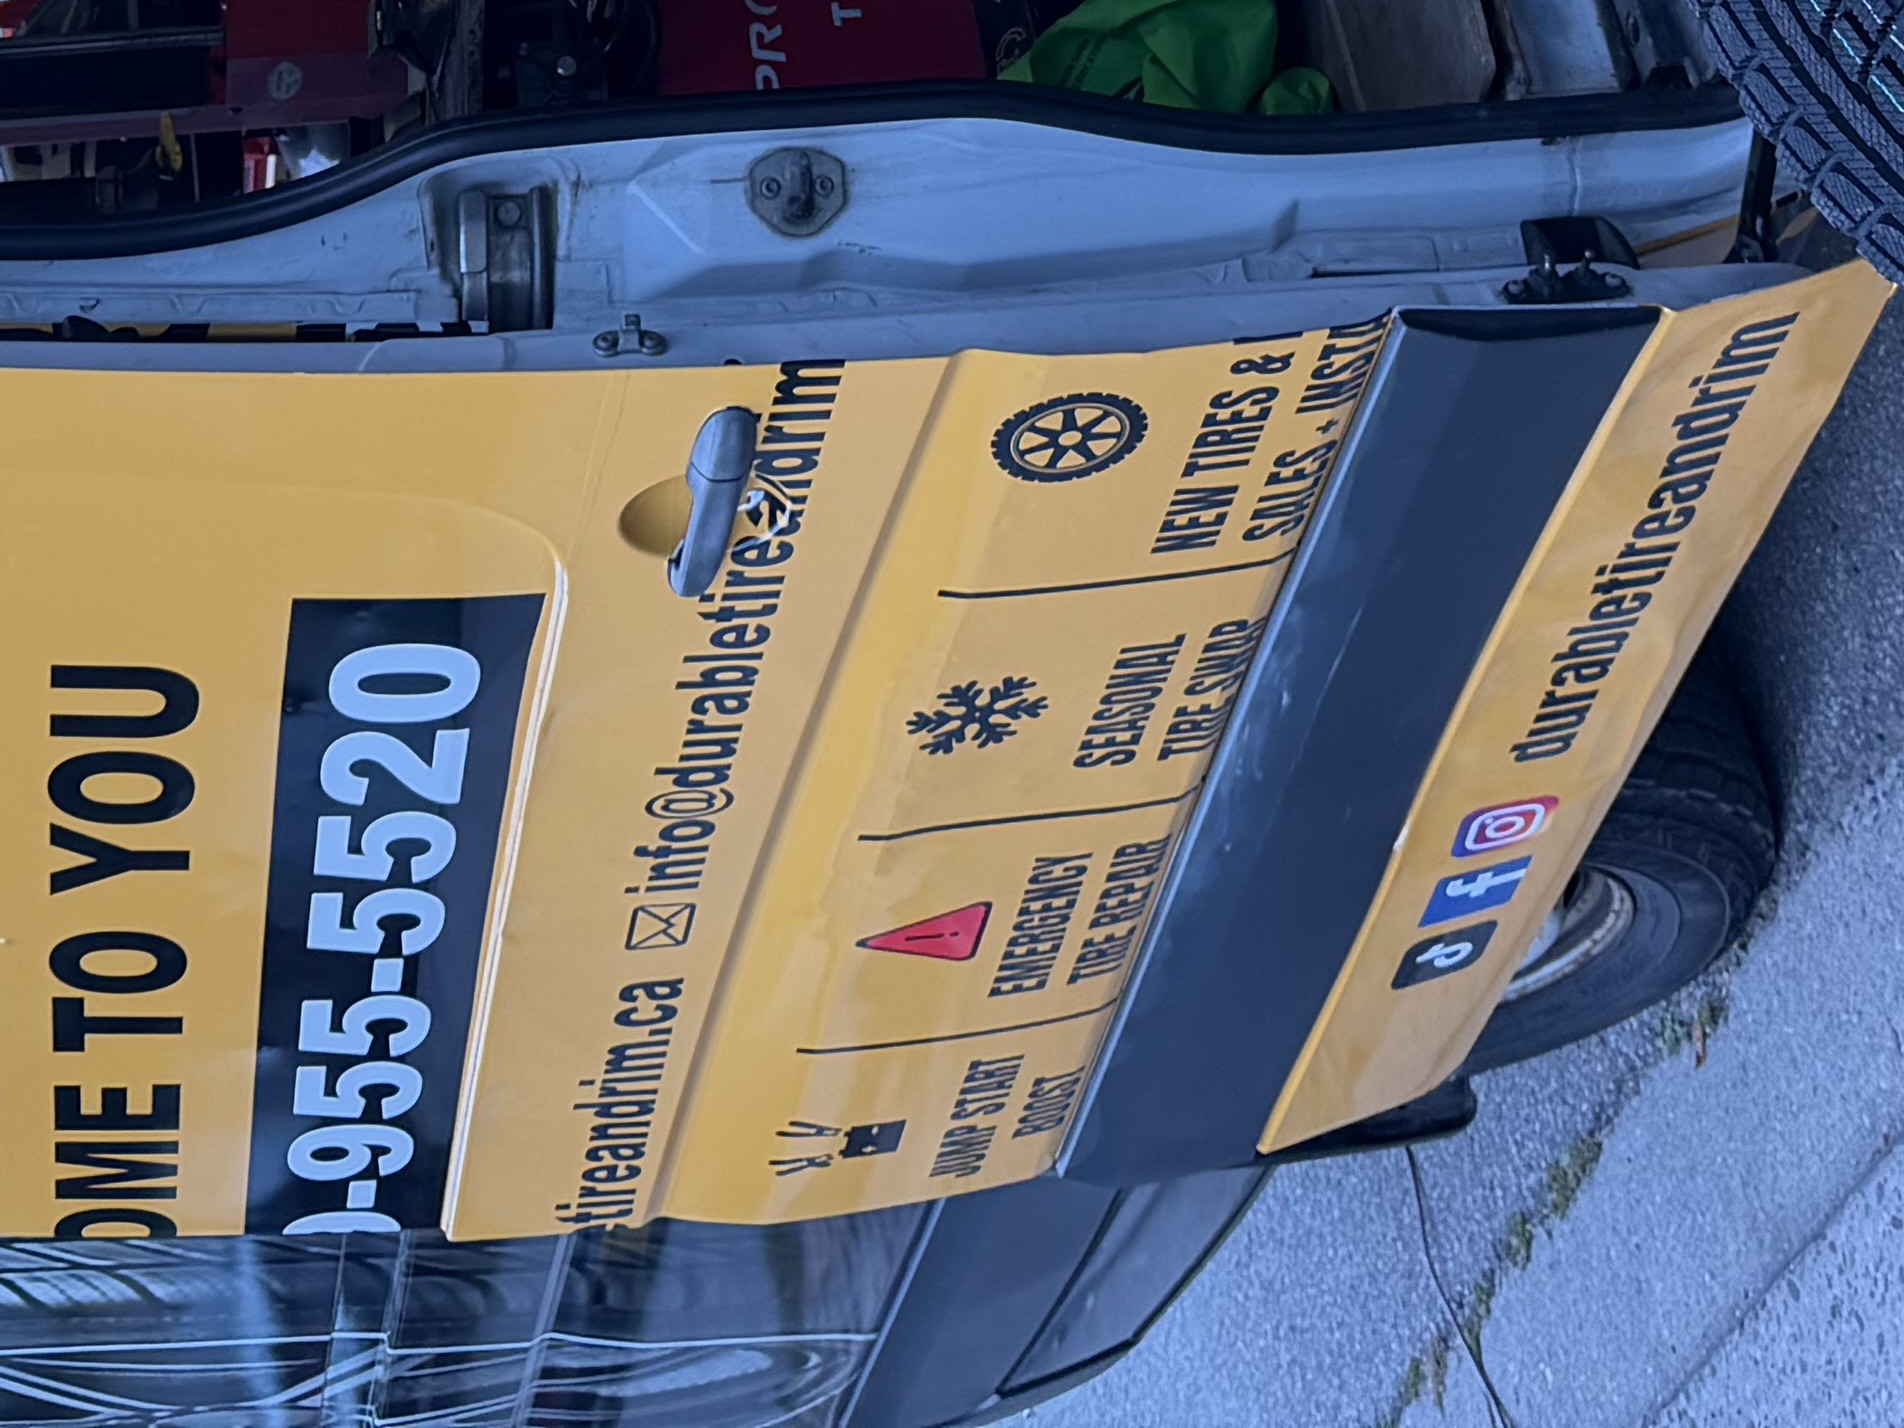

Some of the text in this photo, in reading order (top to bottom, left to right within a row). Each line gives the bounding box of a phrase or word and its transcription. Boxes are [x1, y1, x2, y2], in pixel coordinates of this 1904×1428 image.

[1230, 351, 1295, 374] &
[1180, 387, 1280, 478] TIRES
[1242, 440, 1338, 541] SALES
[1151, 485, 1239, 554] NEW
[1511, 311, 1799, 763] durabletireandrim
[1073, 633, 1187, 768] SEASONAL
[1157, 615, 1266, 761] TIRE SWAP
[47, 664, 200, 895] YOU
[987, 852, 1093, 998] EMERGENCY
[1066, 833, 1172, 985] TIRE REPAIR
[49, 930, 188, 1053] TO
[929, 1054, 1024, 1178] JUMP START
[1012, 1066, 1085, 1139] BOOST
